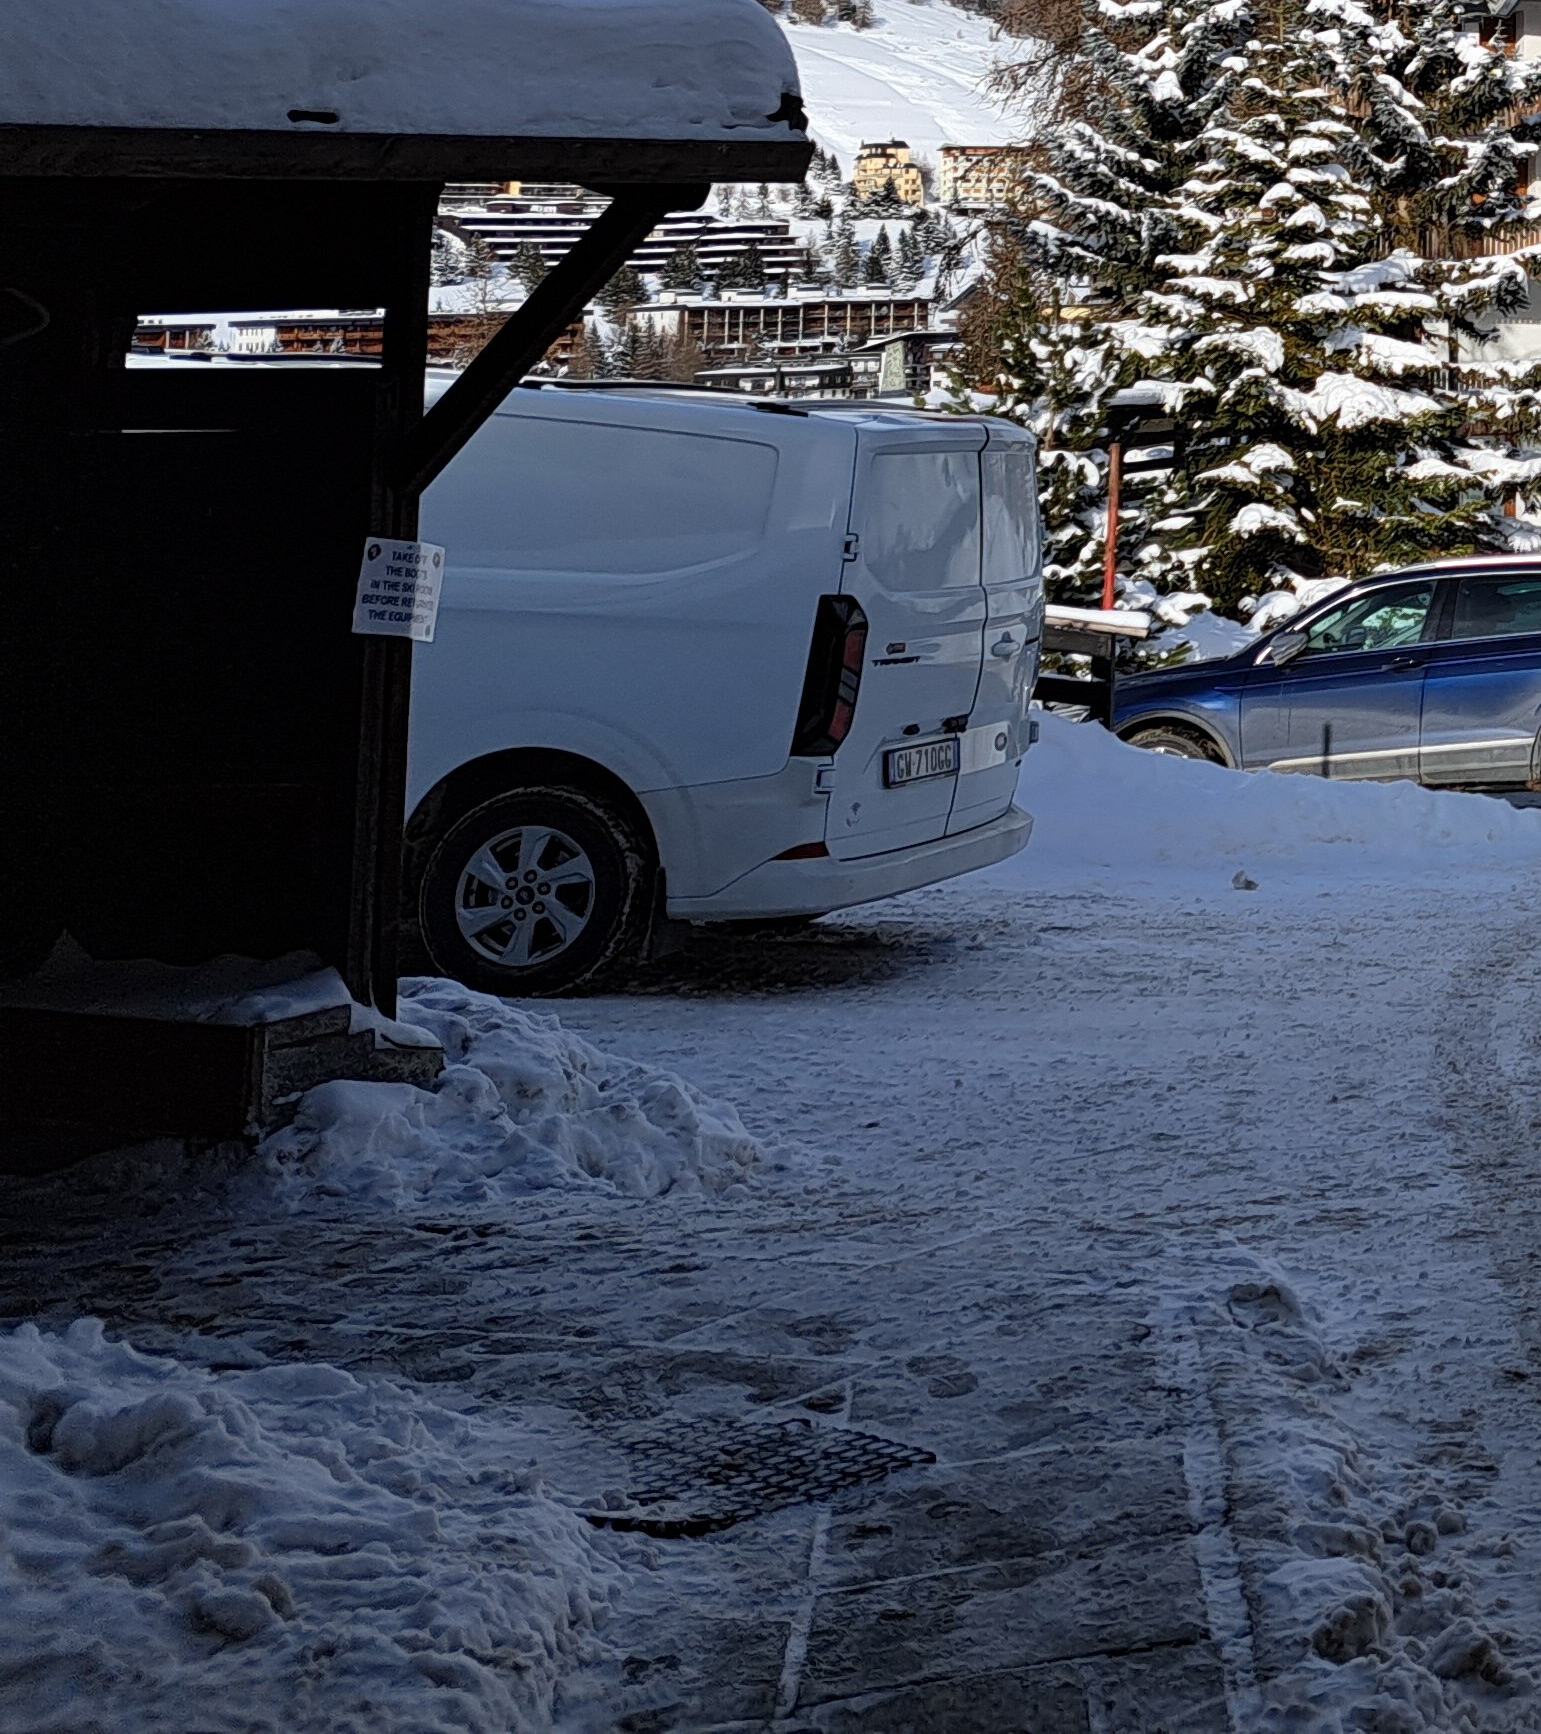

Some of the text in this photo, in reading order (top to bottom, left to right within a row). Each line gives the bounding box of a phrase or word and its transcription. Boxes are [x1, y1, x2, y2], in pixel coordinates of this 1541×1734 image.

[392, 551, 414, 564] TAKE
[386, 565, 402, 576] THE
[370, 581, 380, 589] IN
[383, 580, 401, 591] THE
[361, 594, 399, 606] BEFORE
[368, 609, 427, 623] THE EQUIP
